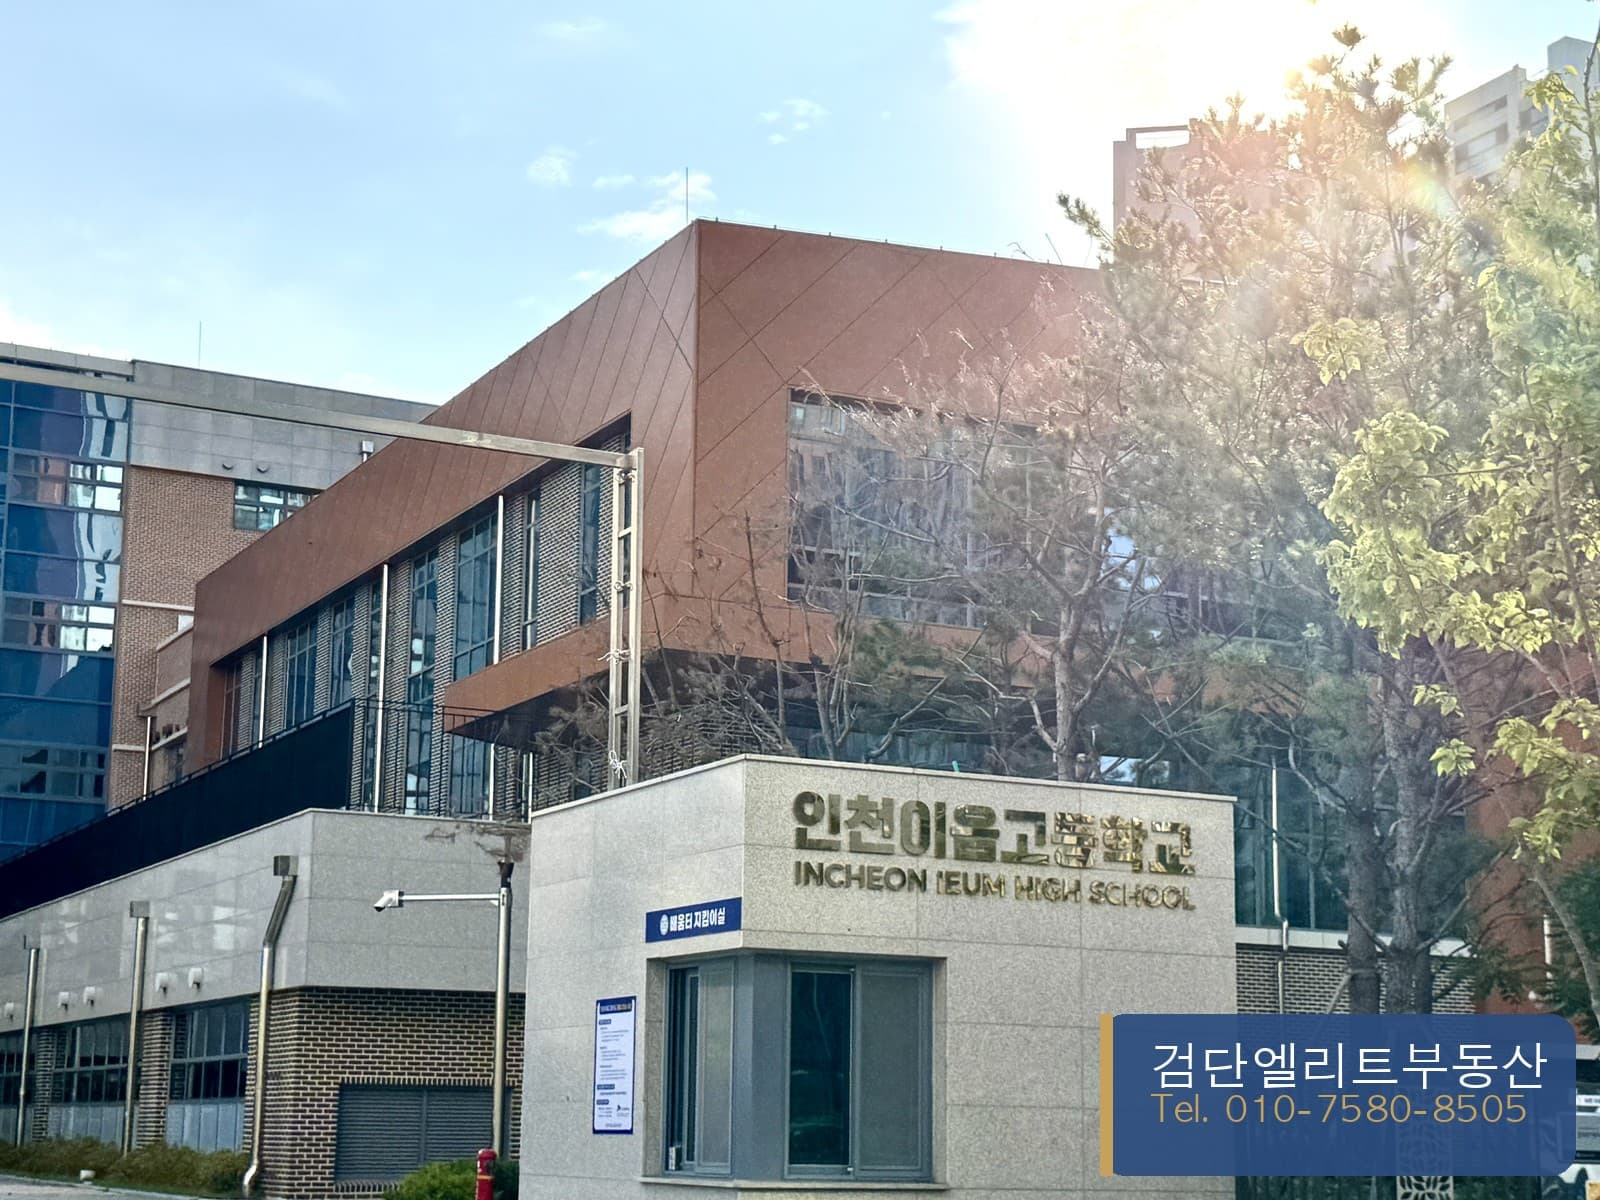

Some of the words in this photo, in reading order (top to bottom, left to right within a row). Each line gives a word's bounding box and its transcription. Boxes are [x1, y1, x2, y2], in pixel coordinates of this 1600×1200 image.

[792, 790, 1195, 875] 인천이음고등학교
[794, 860, 927, 894] INCHEON
[936, 869, 1006, 898] IEUM
[1014, 875, 1081, 904] HIGH
[1089, 881, 1196, 911] SCHOOL
[669, 913, 692, 932] 배움터
[694, 907, 726, 928] 지킴이실
